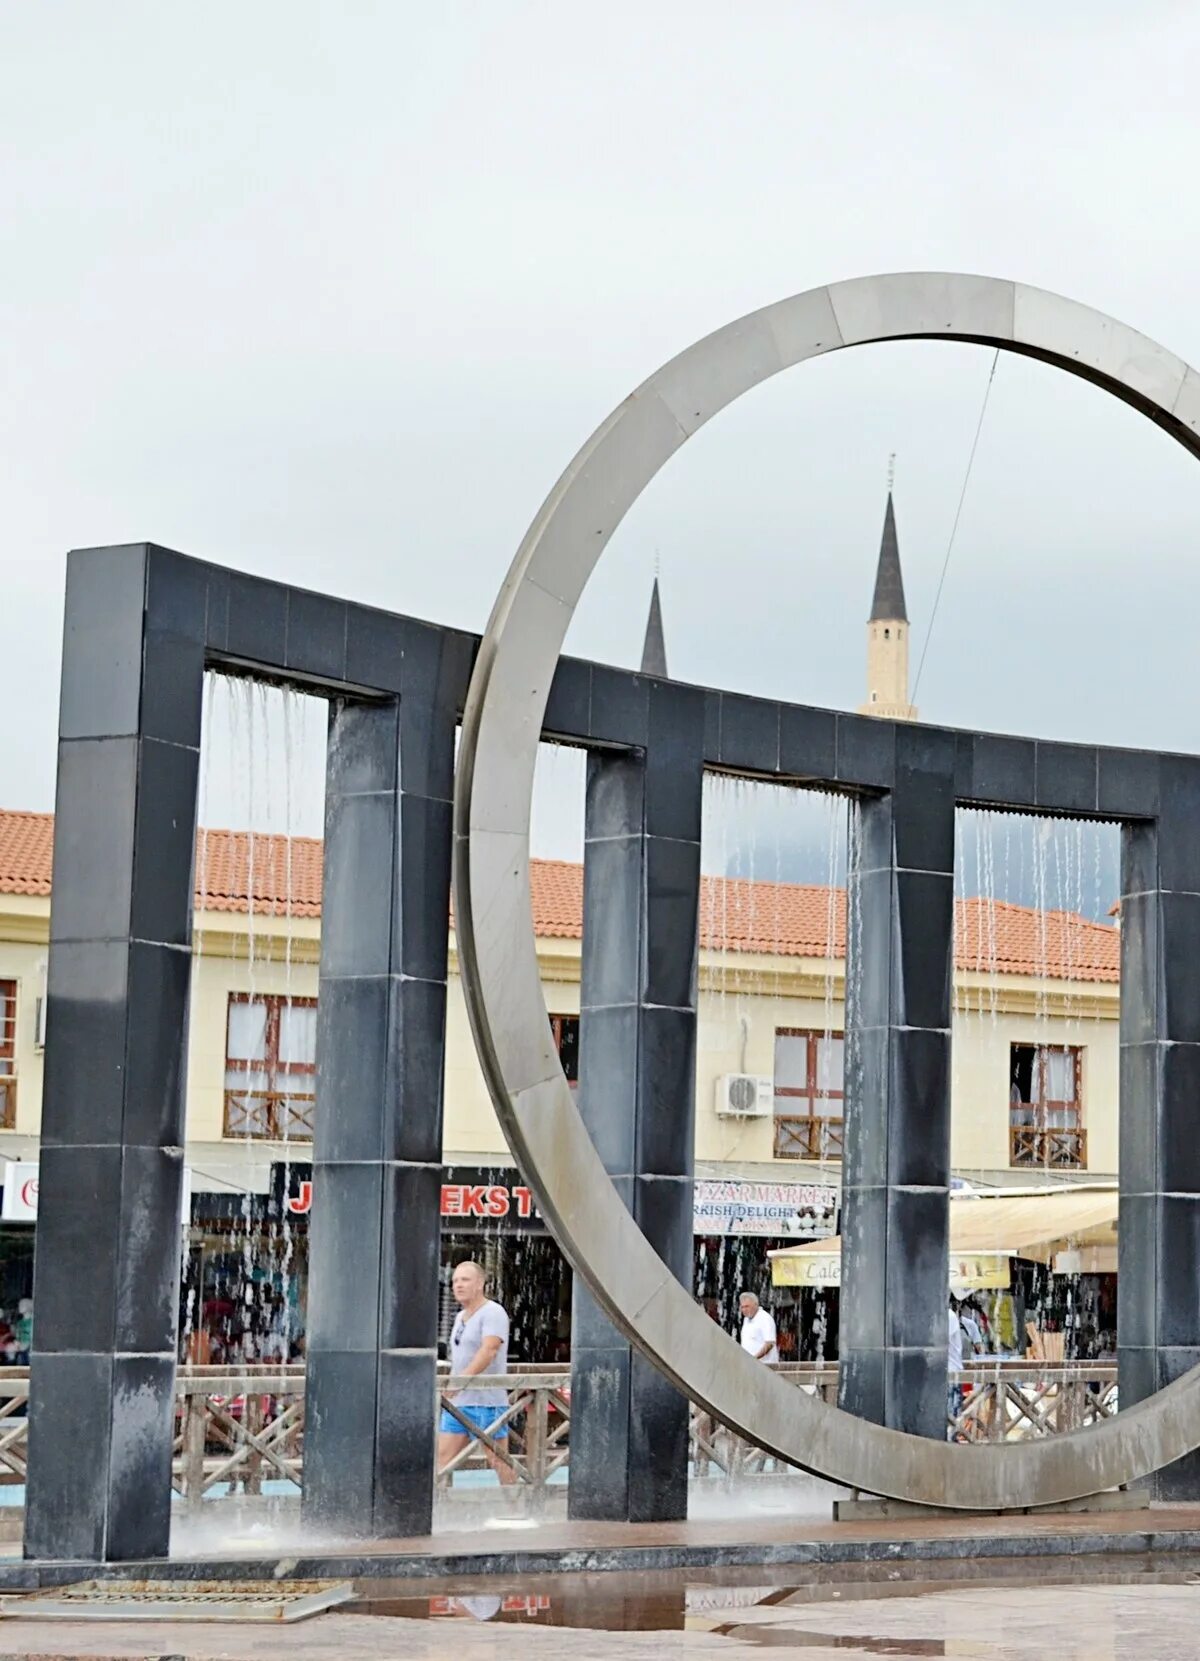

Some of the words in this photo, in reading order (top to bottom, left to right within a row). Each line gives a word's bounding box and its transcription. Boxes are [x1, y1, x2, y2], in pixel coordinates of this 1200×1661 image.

[440, 1185, 540, 1216] EKST
[696, 1183, 751, 1202] EZAR
[756, 1185, 835, 1206] MARKET
[693, 1204, 733, 1216] RKISH
[738, 1206, 797, 1218] DELIGHT
